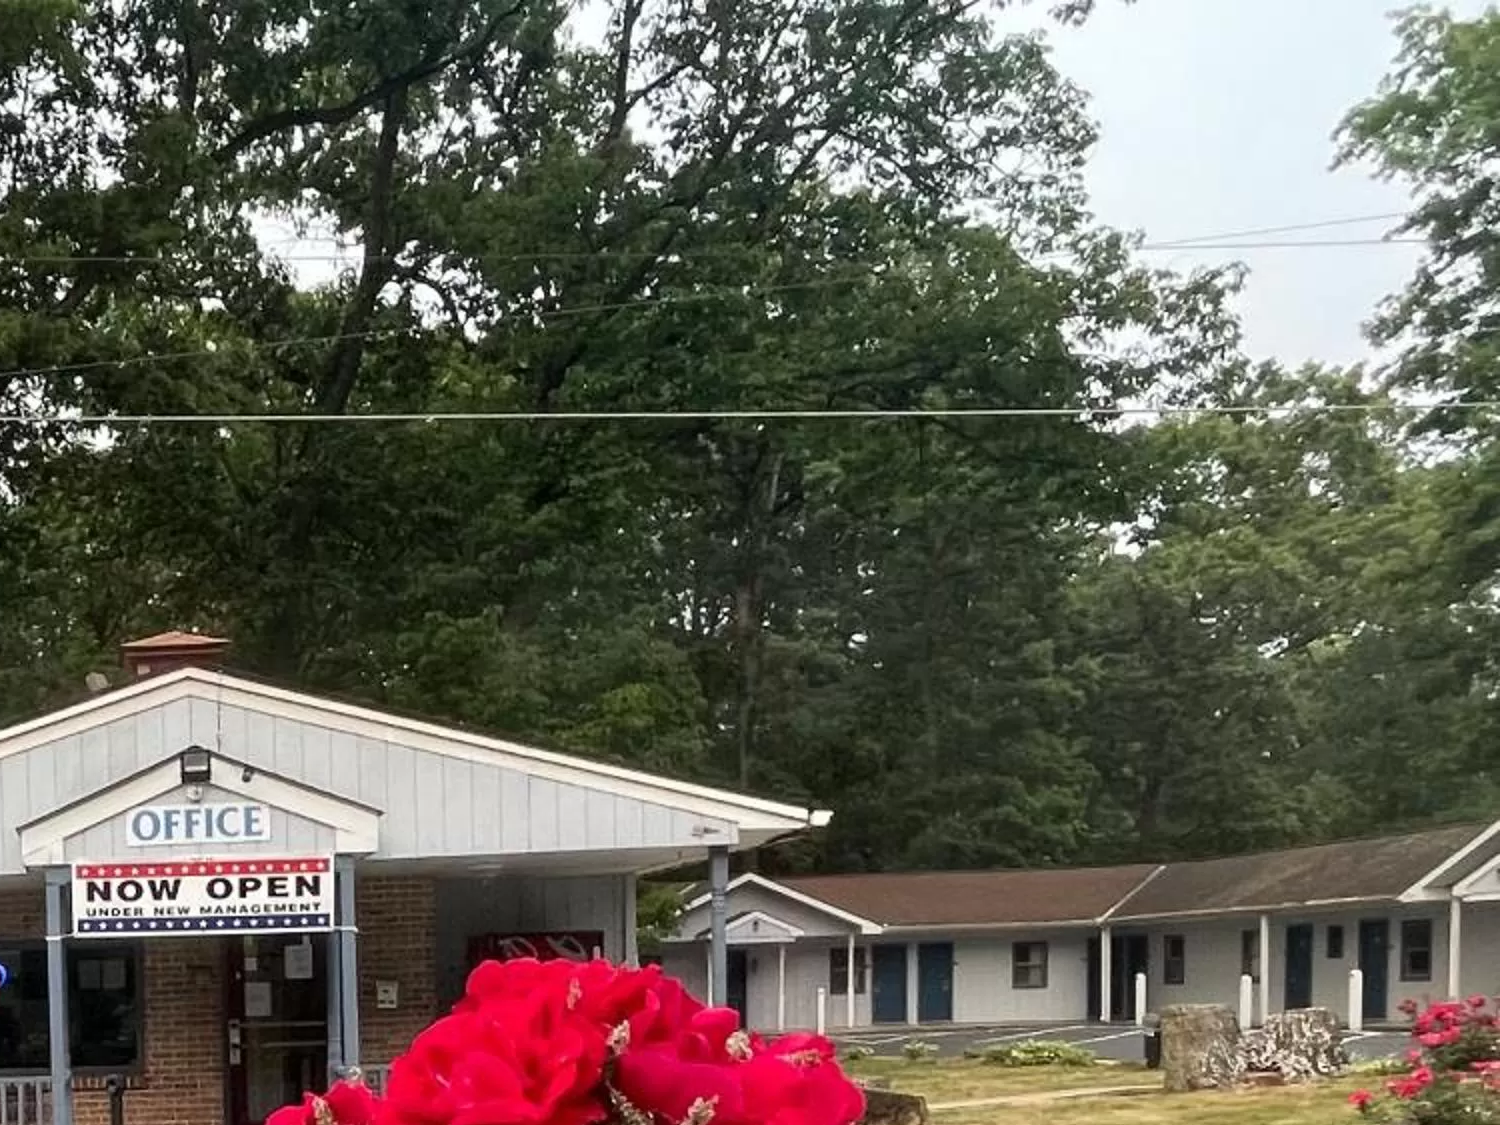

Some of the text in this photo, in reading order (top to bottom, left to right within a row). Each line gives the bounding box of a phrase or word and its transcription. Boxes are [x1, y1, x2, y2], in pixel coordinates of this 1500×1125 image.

[131, 805, 264, 841] OFFICE
[86, 875, 321, 902] NOW OPEN
[86, 902, 321, 917] UNDER NEW MANAGEMENT
